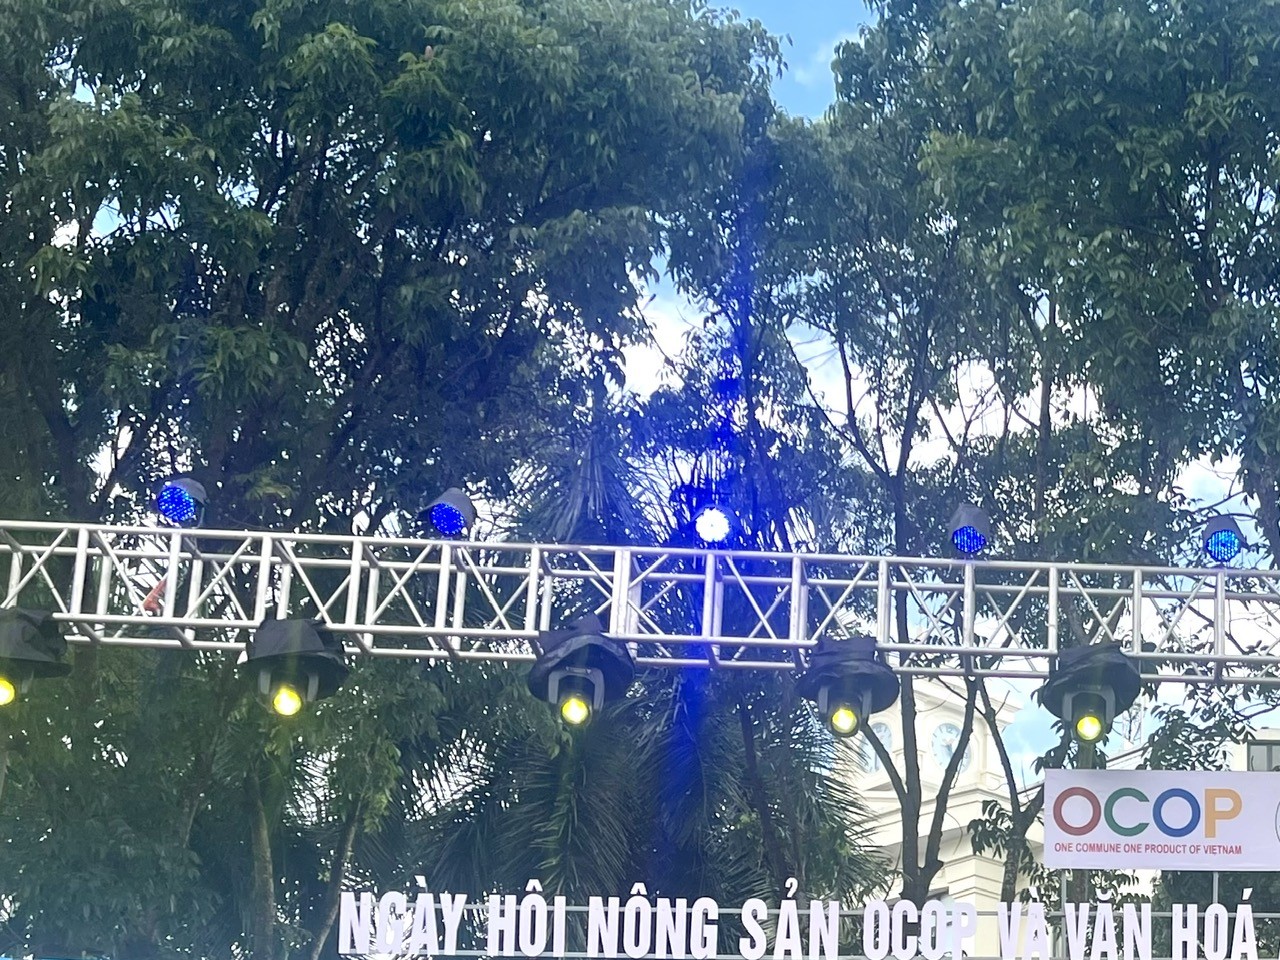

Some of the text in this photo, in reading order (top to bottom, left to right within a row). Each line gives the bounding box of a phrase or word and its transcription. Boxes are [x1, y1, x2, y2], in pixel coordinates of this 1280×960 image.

[1053, 786, 1242, 839] OCOP
[1054, 842, 1073, 853] ONE
[1075, 843, 1121, 853] COMMUNE
[1123, 843, 1142, 853] ONE
[1144, 844, 1187, 854] PRODUCT
[1189, 844, 1202, 854] OF
[338, 877, 468, 957] NGÀY
[586, 882, 719, 960] NÔNG
[739, 877, 840, 960] SẢN
